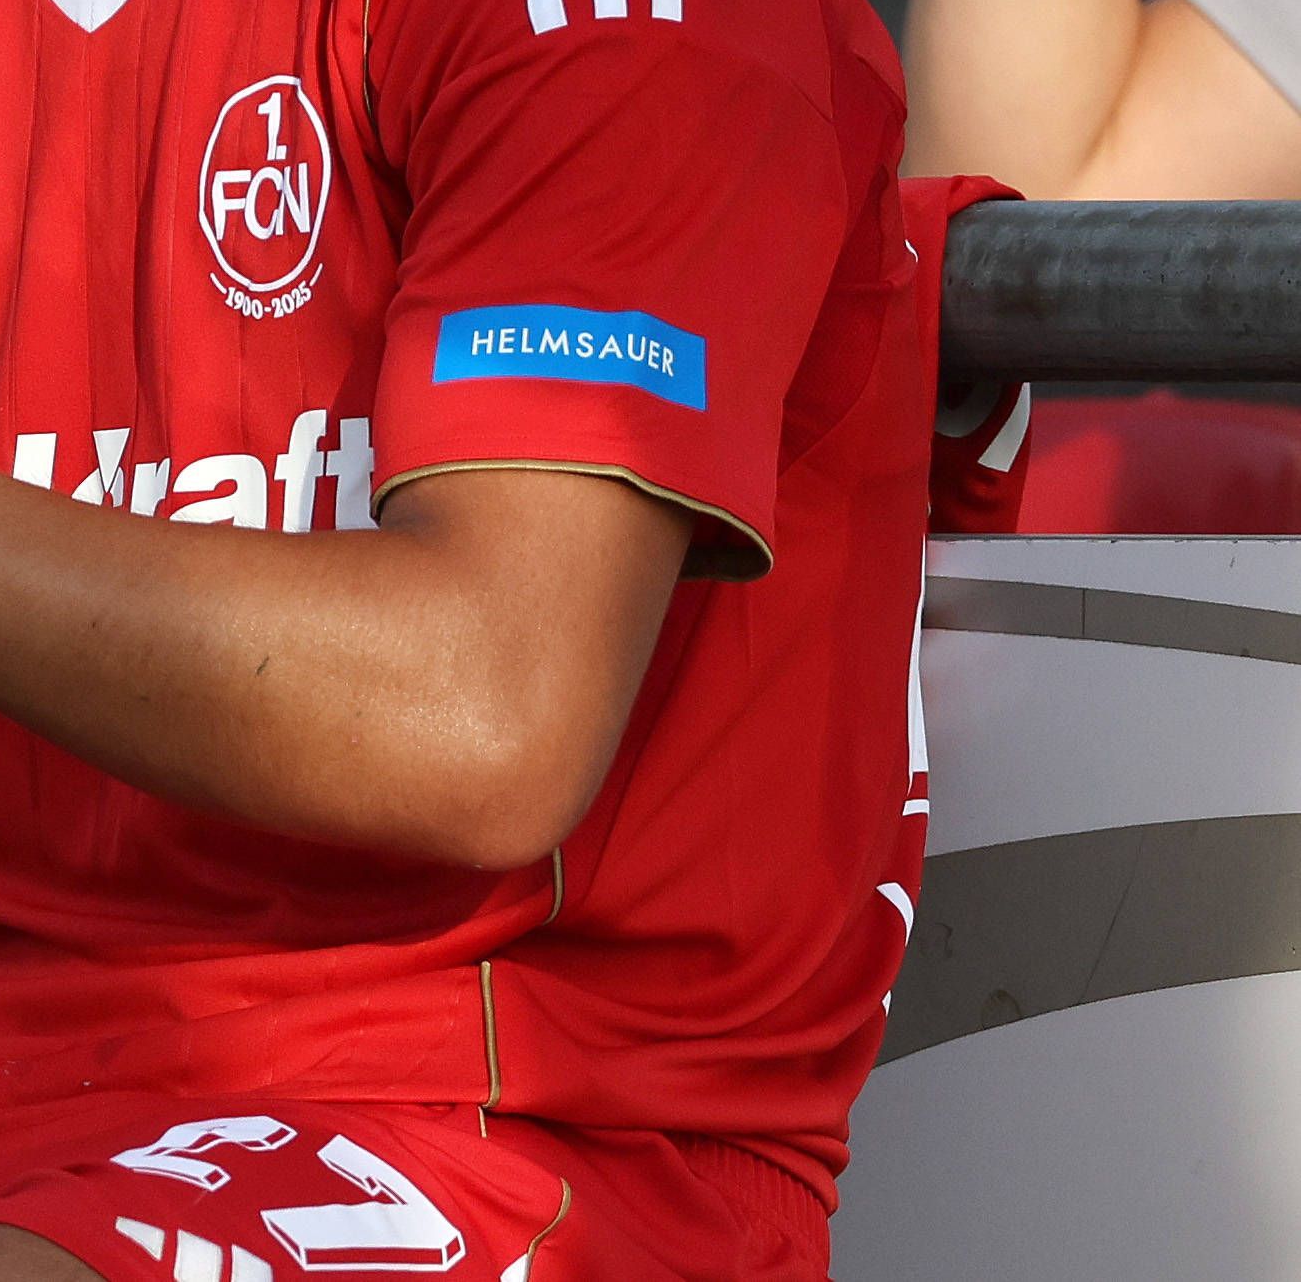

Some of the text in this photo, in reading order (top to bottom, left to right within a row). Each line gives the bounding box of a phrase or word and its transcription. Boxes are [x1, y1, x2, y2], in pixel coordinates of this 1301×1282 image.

[257, 91, 287, 161] 1.
[211, 162, 311, 241] FCN
[224, 280, 312, 320] 1900-2025
[471, 327, 675, 378] HELMSAUER
